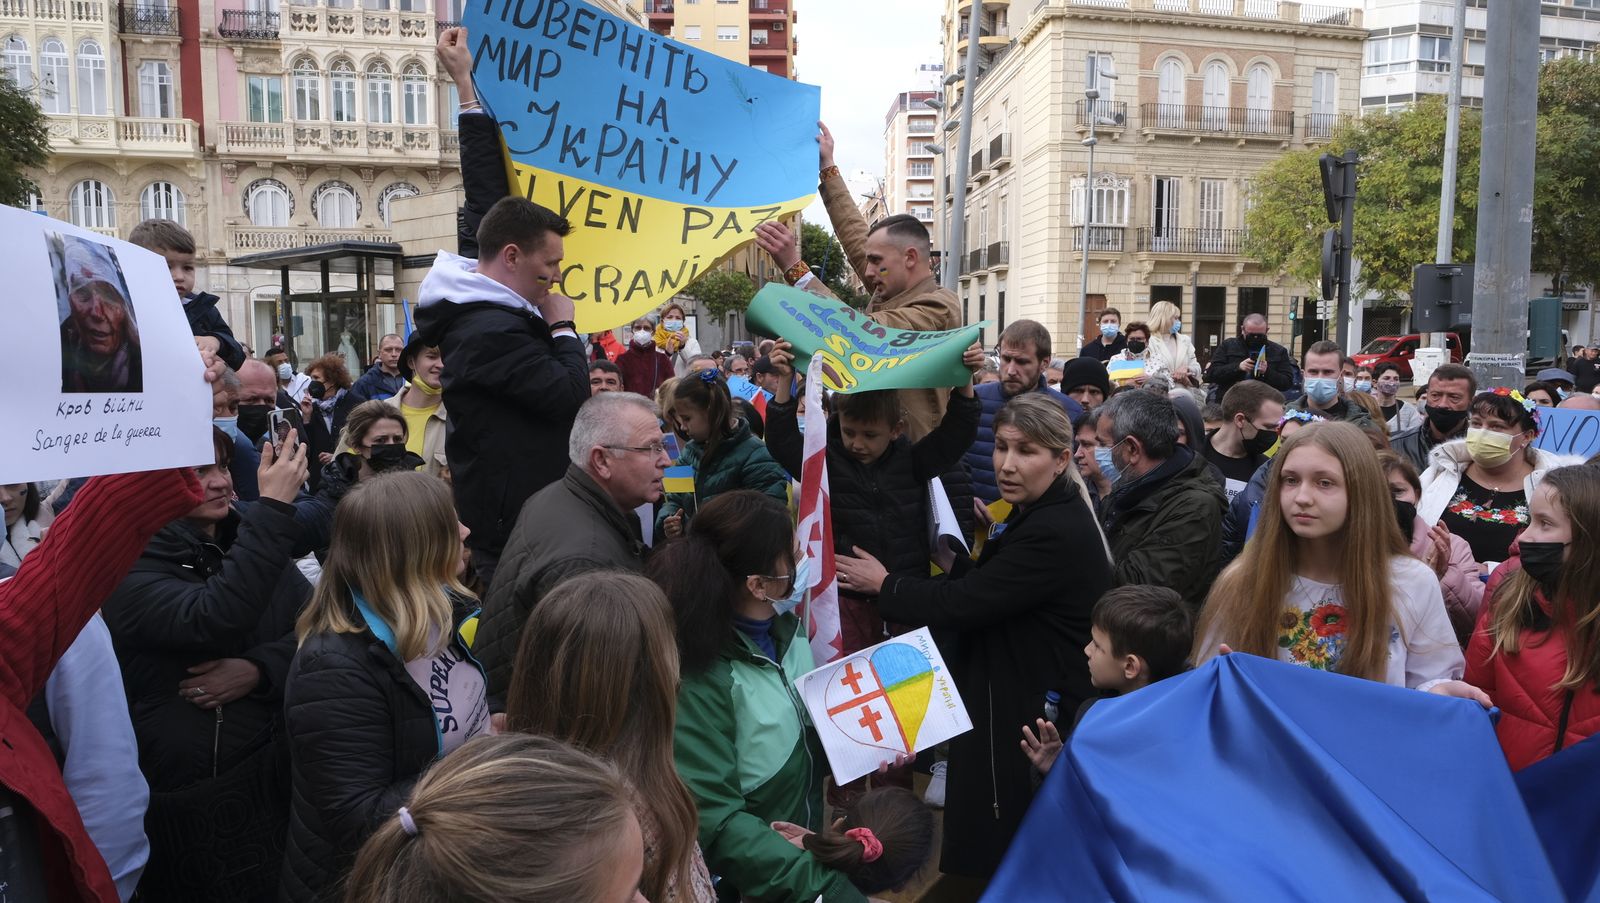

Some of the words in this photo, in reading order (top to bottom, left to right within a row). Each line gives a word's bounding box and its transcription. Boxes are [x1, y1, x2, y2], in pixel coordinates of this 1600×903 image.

[472, 34, 562, 91] МИР
[615, 83, 669, 132] НА
[681, 205, 782, 245] PAZ
[32, 429, 88, 454] Sangre
[94, 427, 108, 443] de
[112, 423, 123, 440] la
[126, 426, 162, 447] guerra
[1538, 414, 1600, 456] NO
